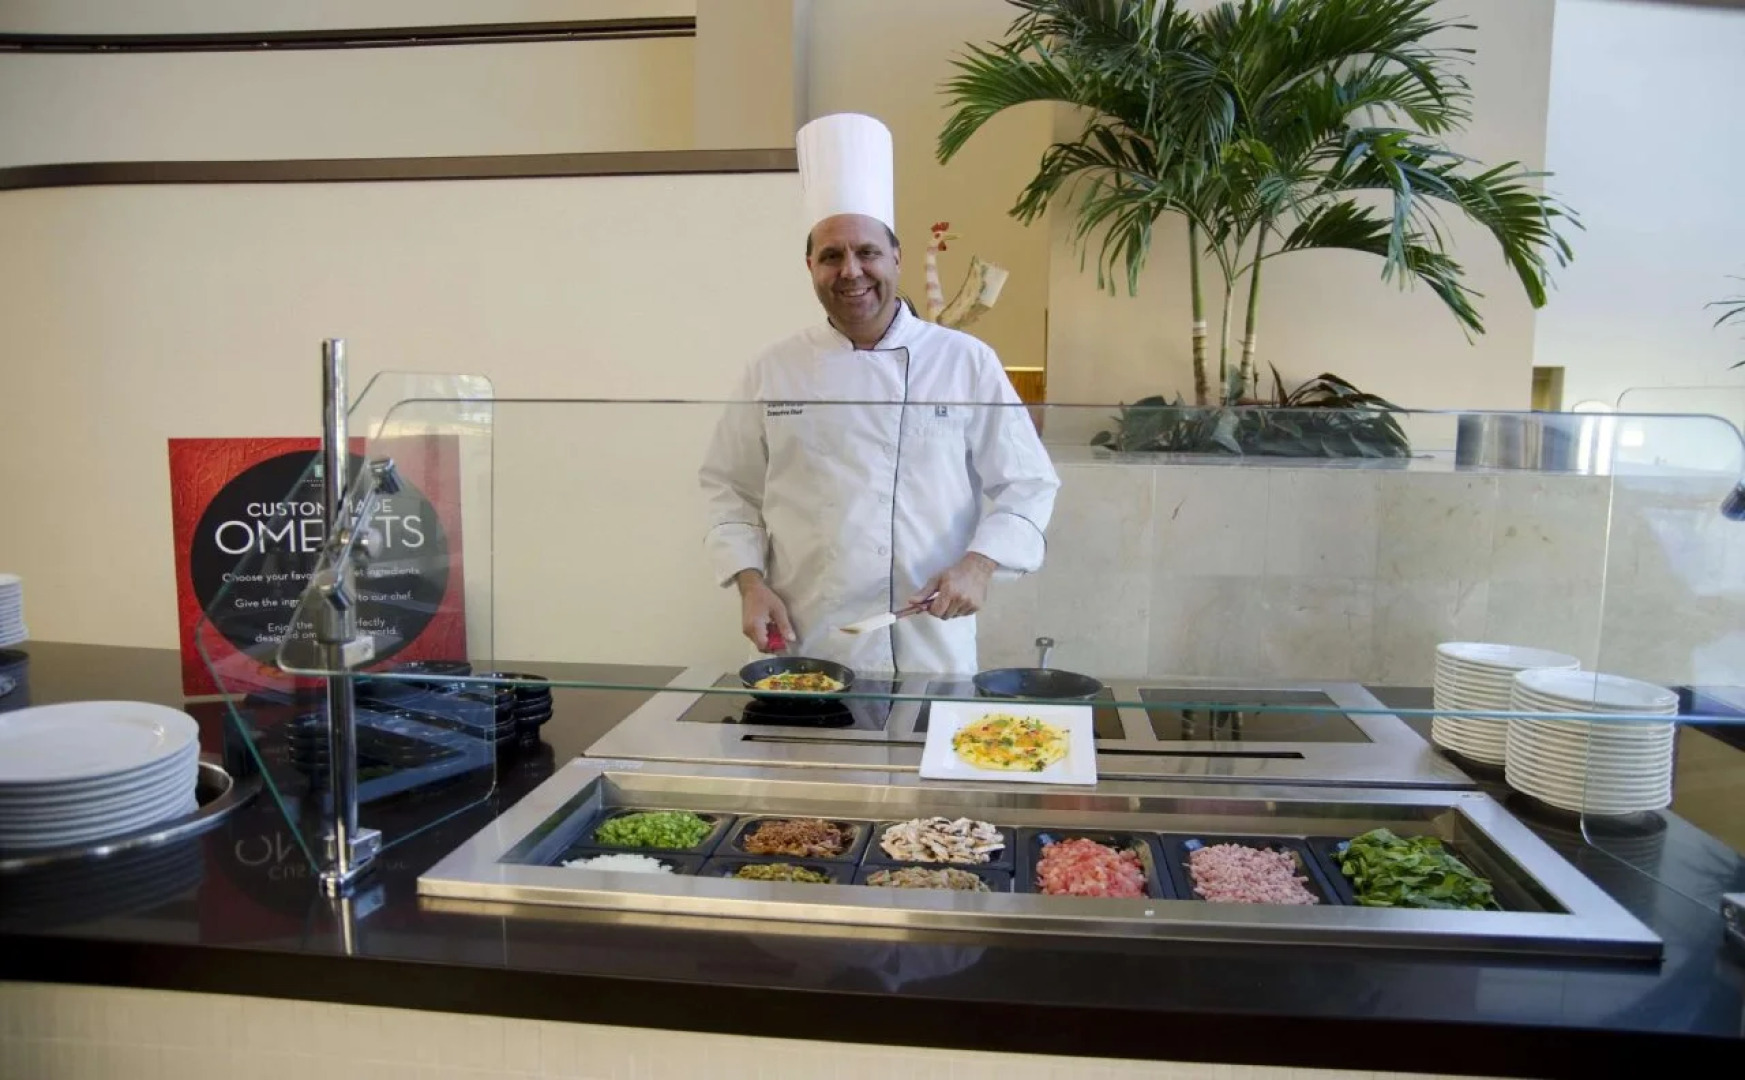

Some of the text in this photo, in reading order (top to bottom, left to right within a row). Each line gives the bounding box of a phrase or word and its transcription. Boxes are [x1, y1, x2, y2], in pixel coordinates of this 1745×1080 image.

[215, 515, 425, 555] OMETS
[266, 573, 288, 584] your
[291, 571, 314, 580] favo
[367, 567, 420, 578] ingredients
[235, 598, 259, 608] Give
[262, 597, 278, 607] the
[358, 594, 369, 602] to
[371, 593, 387, 601] our
[267, 622, 290, 634] Enjo
[296, 621, 313, 630] the
[255, 629, 299, 643] designd
